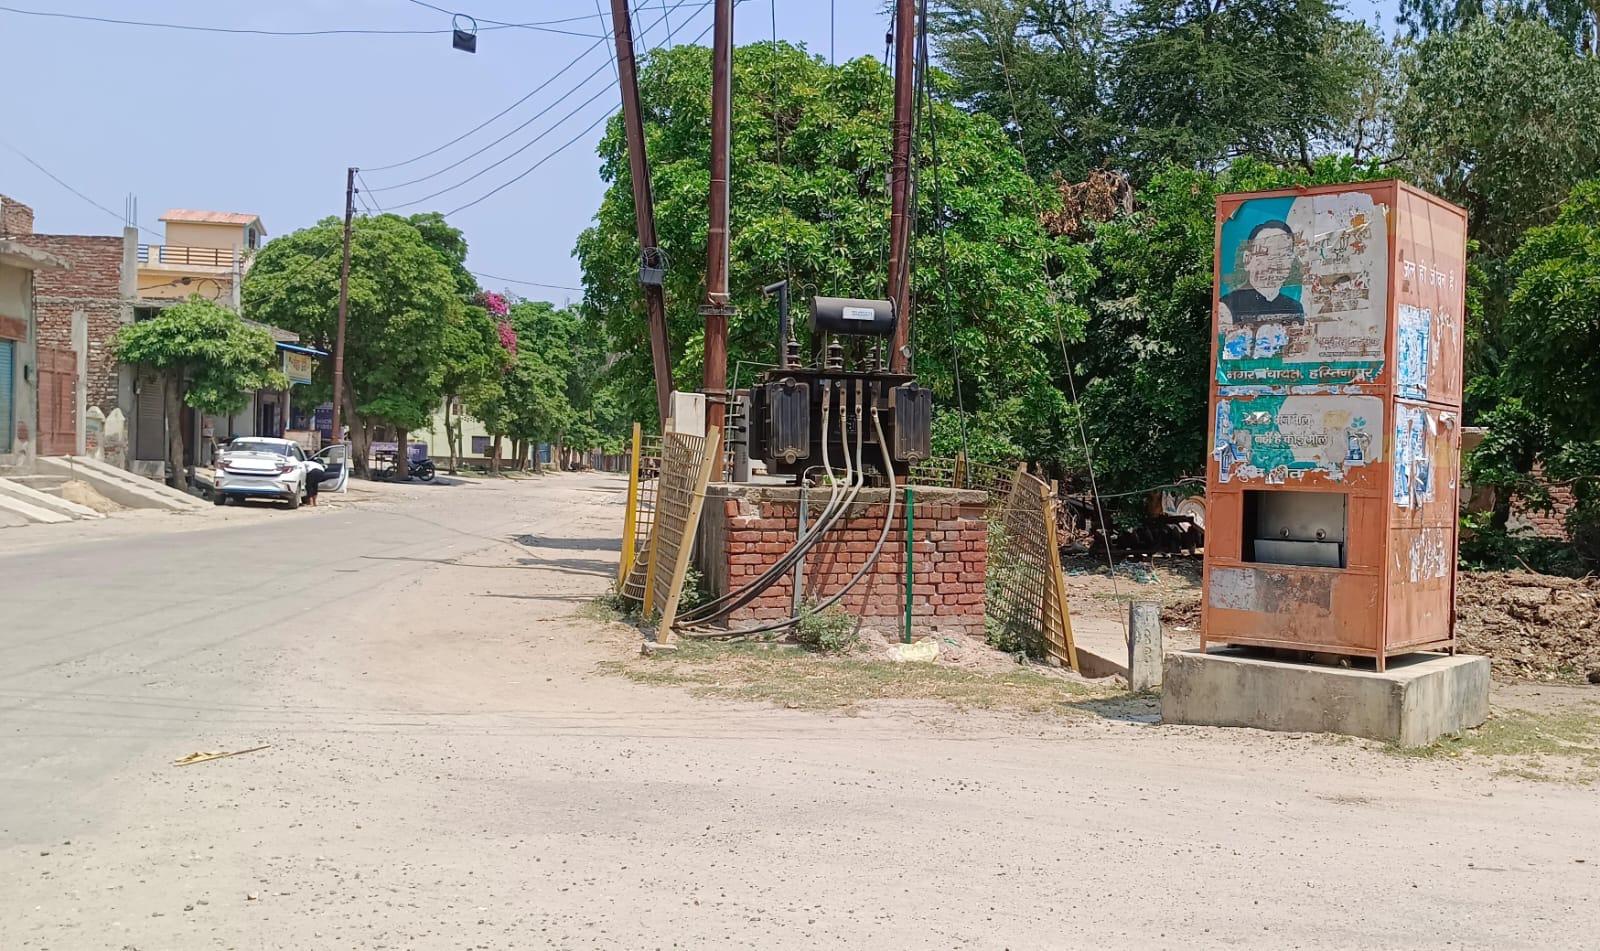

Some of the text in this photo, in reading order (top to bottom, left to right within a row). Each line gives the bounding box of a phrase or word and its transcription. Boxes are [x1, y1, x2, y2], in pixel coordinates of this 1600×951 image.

[1403, 259, 1416, 280] जल
[1429, 264, 1446, 289] जीवन
[1226, 370, 1255, 380] नगर
